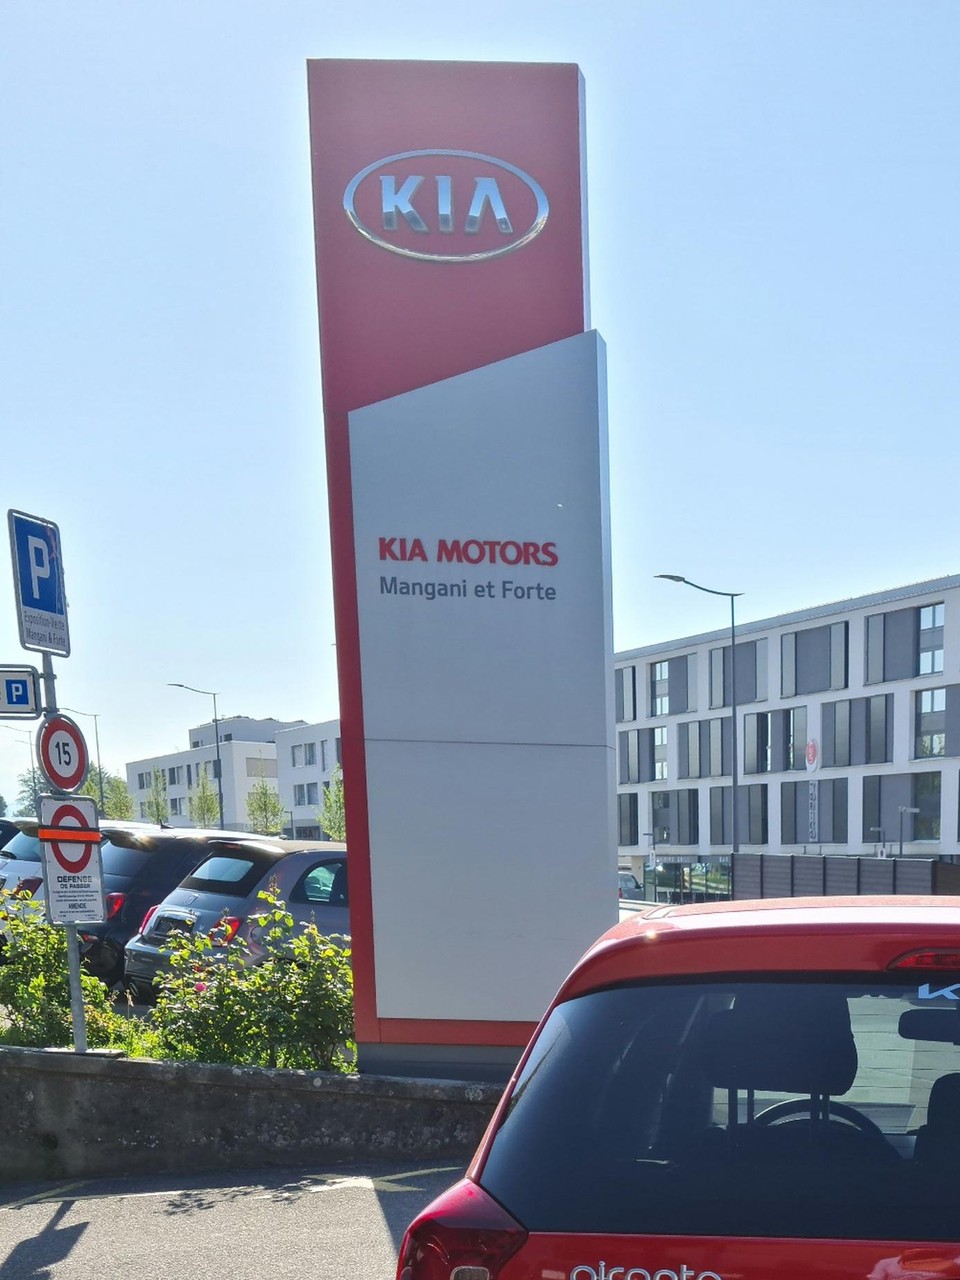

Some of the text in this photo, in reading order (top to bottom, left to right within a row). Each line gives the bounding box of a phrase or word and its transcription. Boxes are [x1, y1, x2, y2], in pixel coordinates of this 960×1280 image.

[379, 174, 513, 234] KIA
[378, 537, 558, 567] KIA MOTORS
[27, 535, 51, 600] P
[380, 576, 556, 601] Mangani et Forte
[11, 683, 23, 702] P
[55, 741, 72, 767] 15
